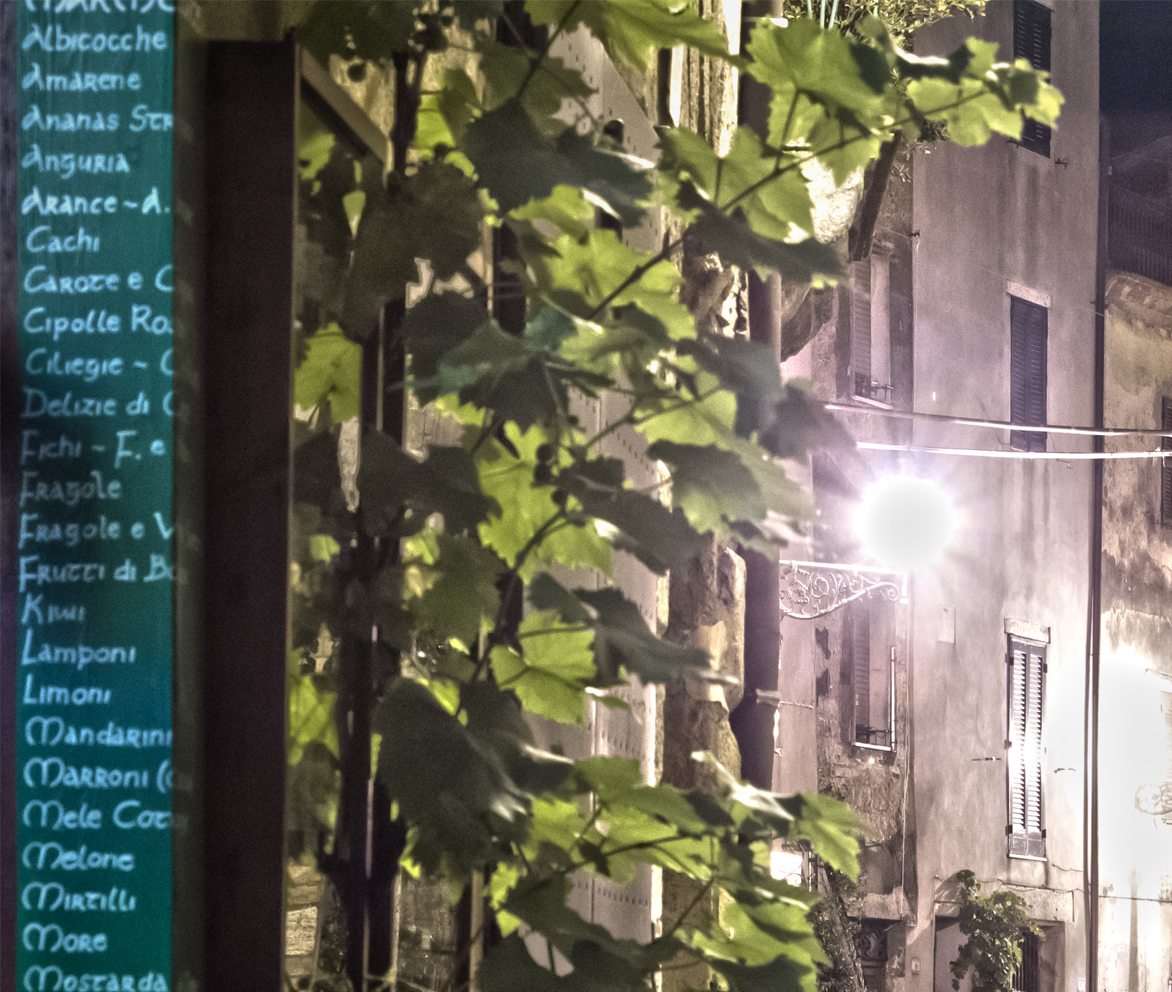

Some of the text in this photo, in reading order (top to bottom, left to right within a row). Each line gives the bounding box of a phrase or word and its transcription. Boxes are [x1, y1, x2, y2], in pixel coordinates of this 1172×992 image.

[22, 23, 167, 52] Albicocche
[21, 104, 119, 132] Ananas
[21, 186, 118, 215] Arance
[26, 225, 100, 253] Cachi
[127, 272, 143, 290] e
[23, 306, 120, 342] Cipolle
[125, 391, 149, 416] di
[150, 438, 165, 455] e
[20, 470, 122, 507] Fragole
[18, 513, 121, 550] Fragole
[130, 521, 145, 540] e
[113, 559, 137, 582] di
[21, 628, 136, 670] Lamponi
[22, 673, 111, 705] Limoni
[23, 799, 102, 830] Mele
[22, 841, 135, 871] Melone
[22, 922, 108, 952] More
